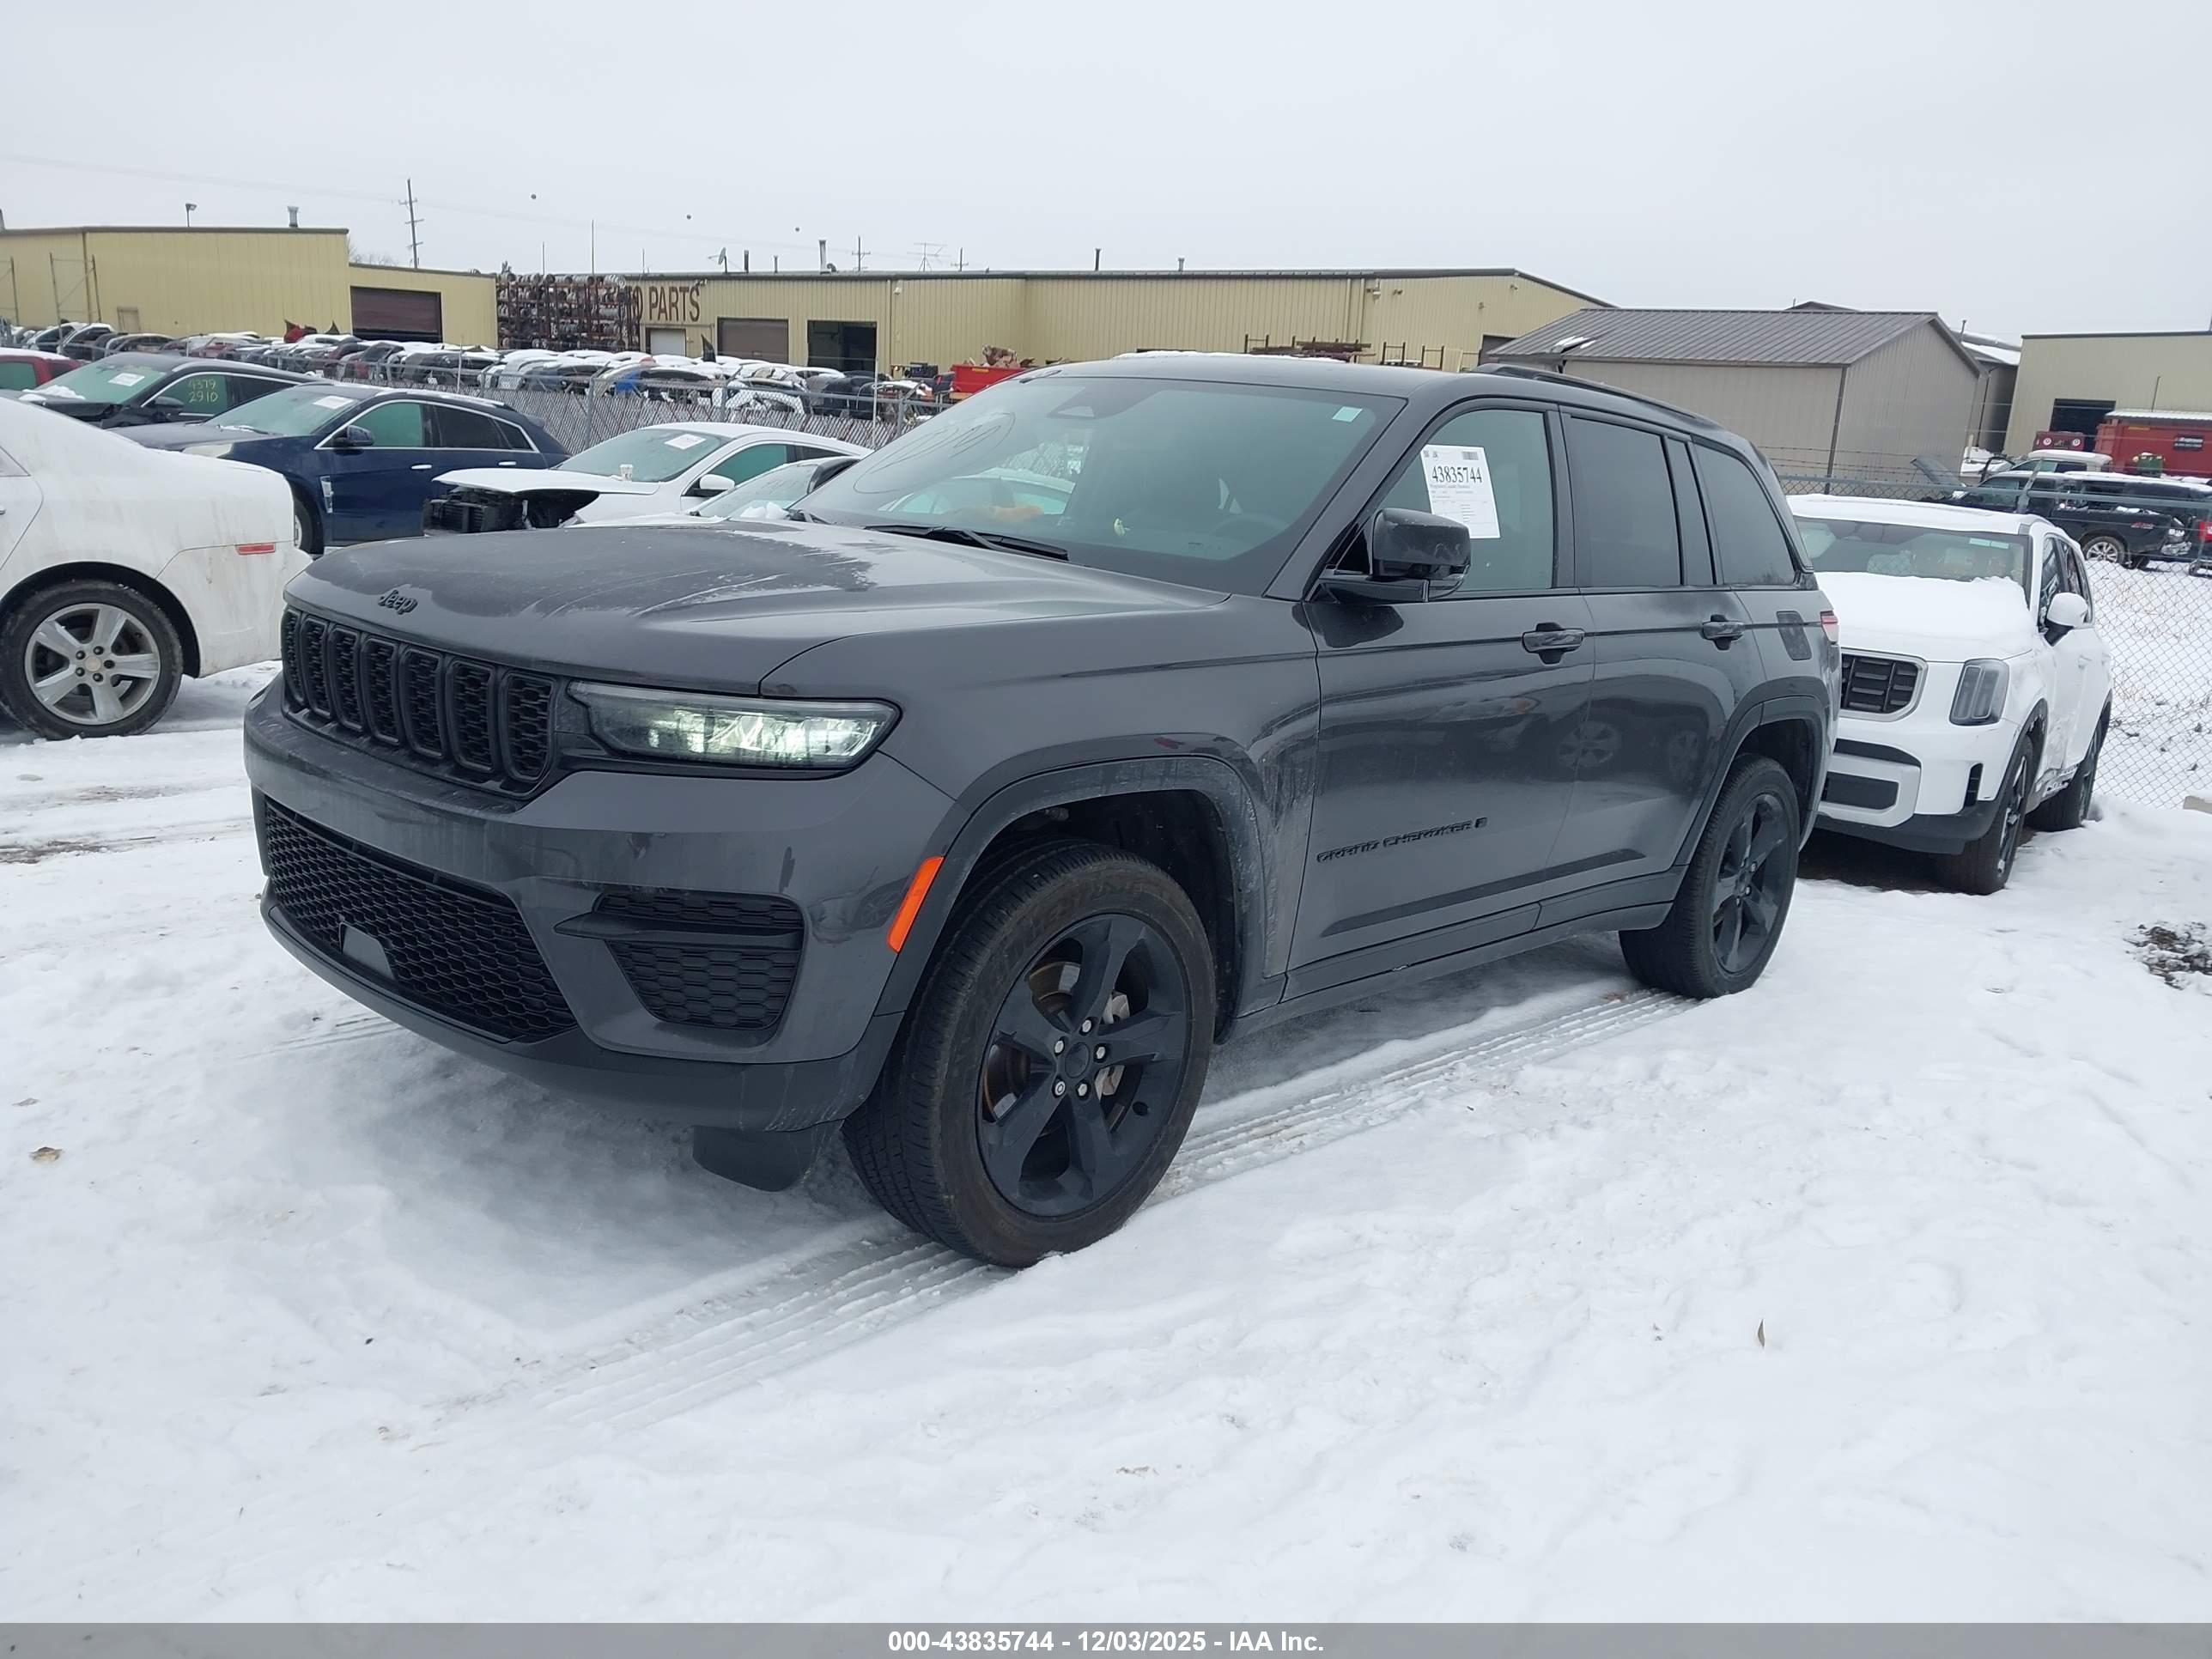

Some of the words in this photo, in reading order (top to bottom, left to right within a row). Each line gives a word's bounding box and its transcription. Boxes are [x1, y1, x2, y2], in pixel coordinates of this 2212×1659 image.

[649, 286, 701, 322] PARTS
[188, 390, 219, 404] 2910
[1431, 465, 1483, 483] 43835744
[378, 589, 418, 615] Jeep
[1316, 839, 1380, 862] GRAND
